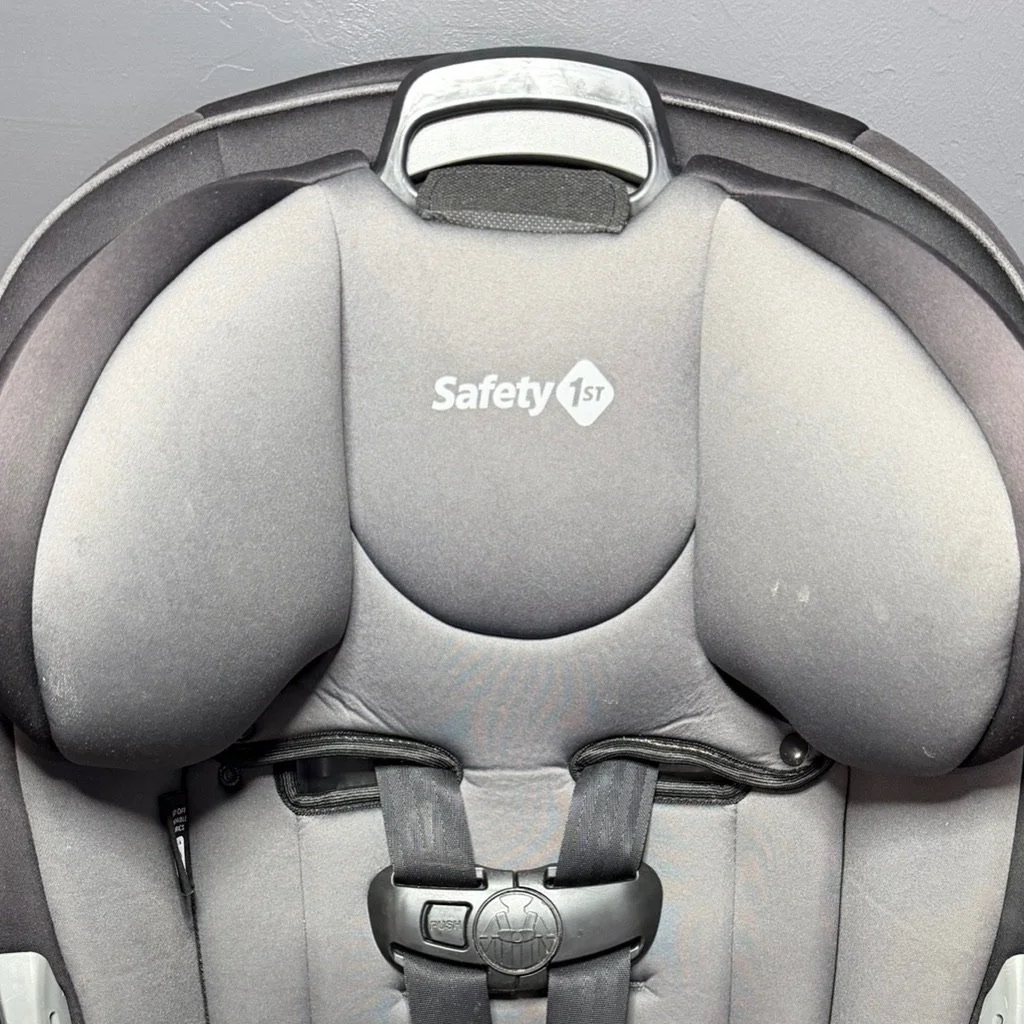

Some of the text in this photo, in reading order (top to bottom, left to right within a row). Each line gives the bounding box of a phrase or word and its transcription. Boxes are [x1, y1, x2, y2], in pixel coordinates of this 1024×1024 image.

[431, 374, 606, 417] Safety 1ST
[430, 919, 461, 931] PUSH
